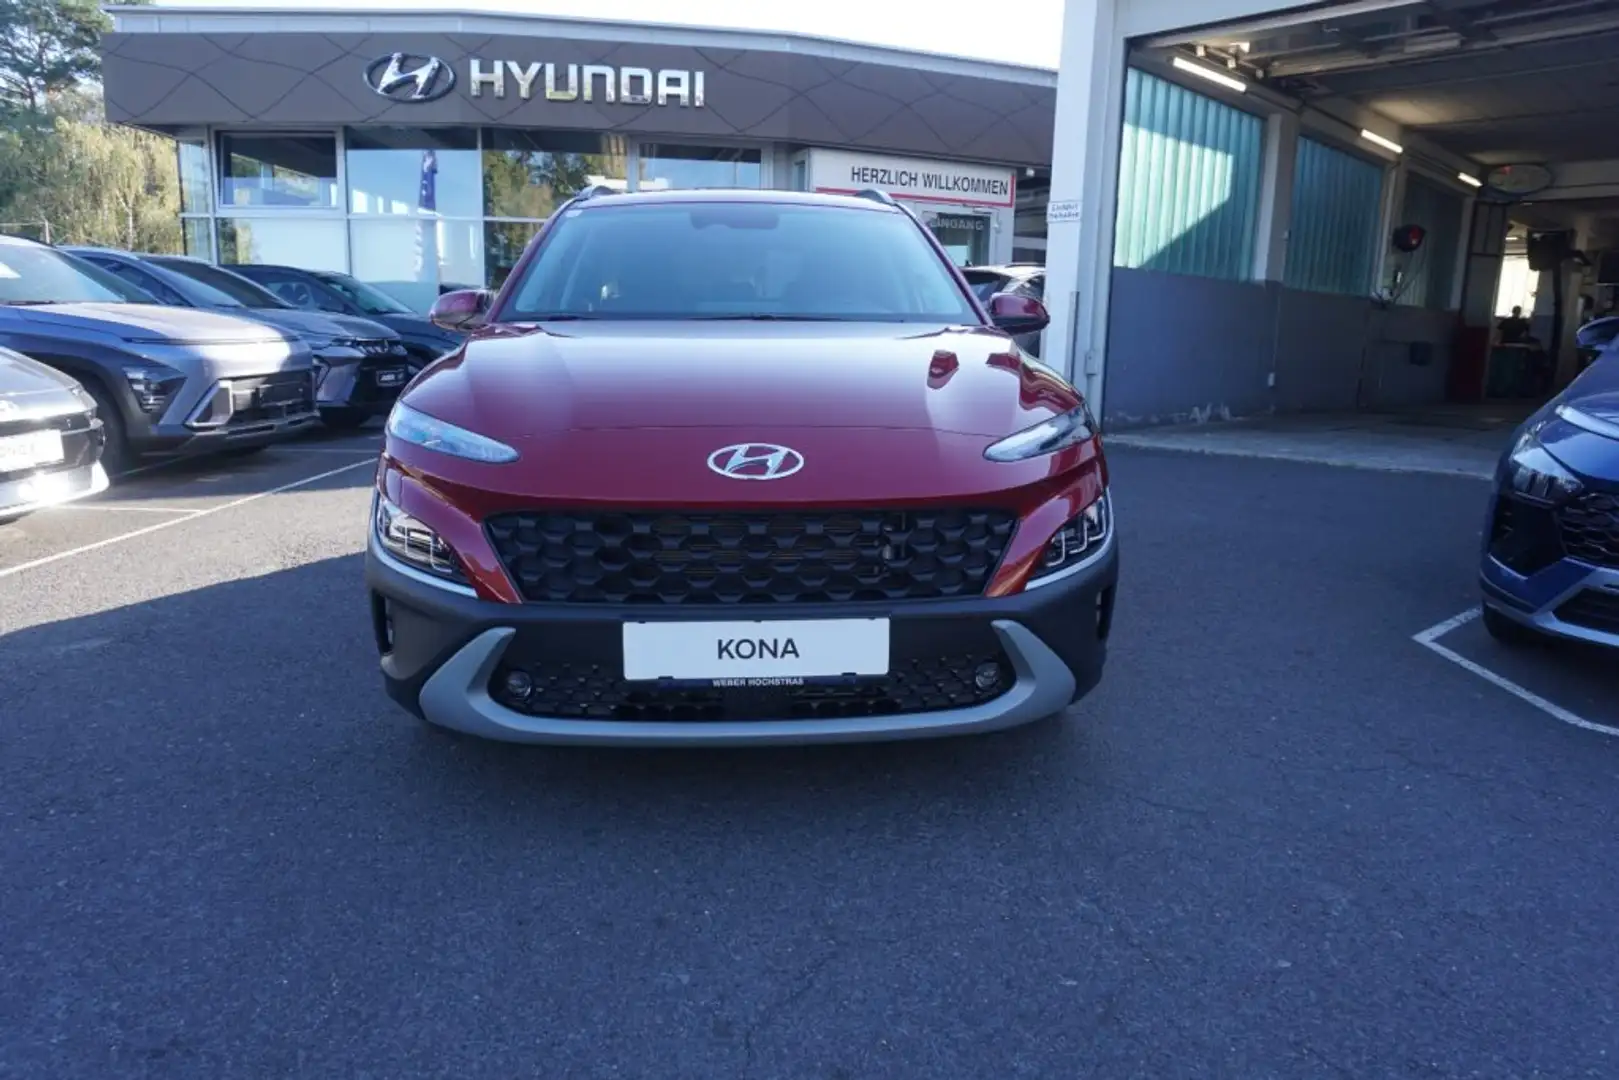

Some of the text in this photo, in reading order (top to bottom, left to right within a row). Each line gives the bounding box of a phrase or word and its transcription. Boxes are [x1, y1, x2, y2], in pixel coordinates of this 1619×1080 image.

[469, 59, 705, 107] HYUNDAI
[851, 166, 1009, 196] HERZLICH WILLKOMMEN
[717, 638, 800, 660] KONA
[712, 679, 746, 688] WEBER
